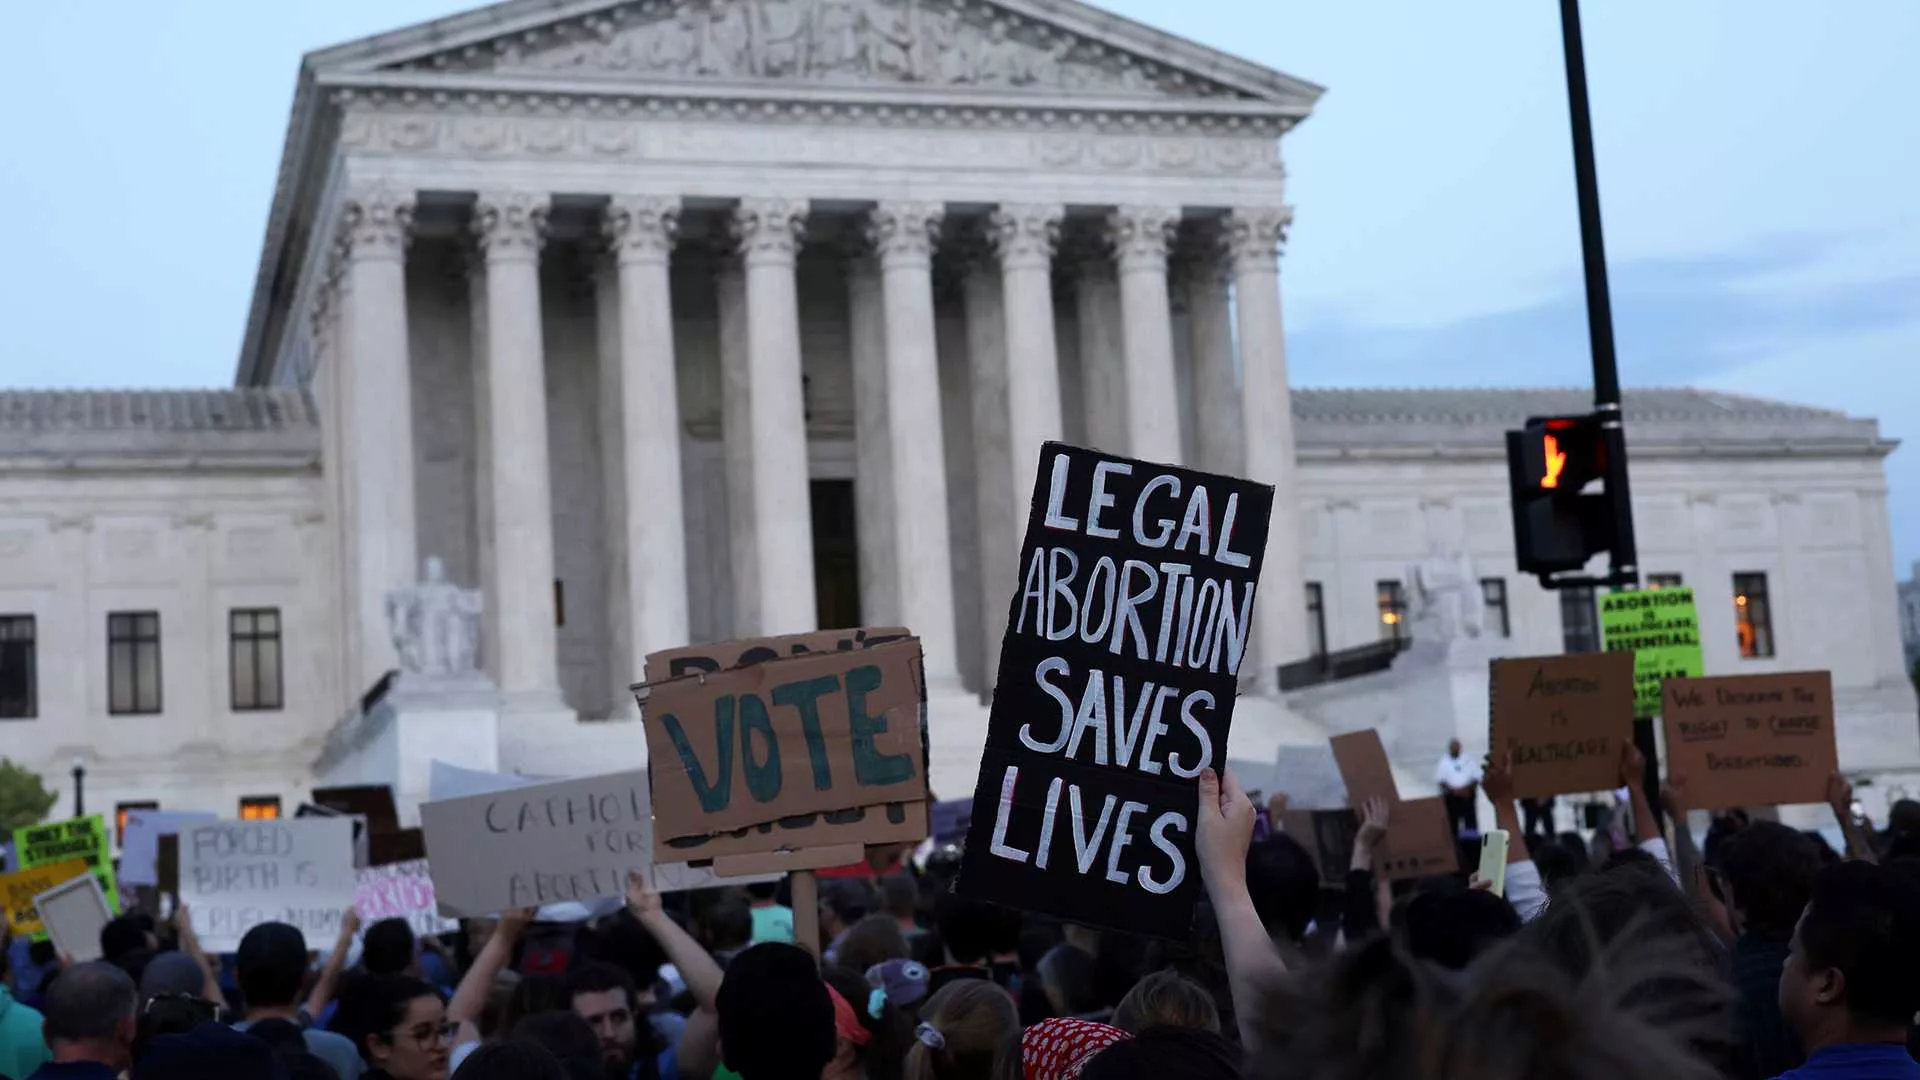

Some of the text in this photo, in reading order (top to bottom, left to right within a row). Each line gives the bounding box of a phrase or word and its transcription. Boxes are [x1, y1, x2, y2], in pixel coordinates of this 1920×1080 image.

[1043, 453, 1251, 568] LEGAL
[1016, 547, 1255, 675] ABORTION
[1603, 592, 1693, 611] ABORTION
[1635, 668, 1688, 684] UMAN
[660, 665, 916, 813] VOTE
[1019, 656, 1216, 779] SAVES
[192, 825, 294, 860] FORCED
[586, 829, 645, 853] FOR
[990, 765, 1187, 895] LIVES
[193, 860, 280, 896] BIRTH
